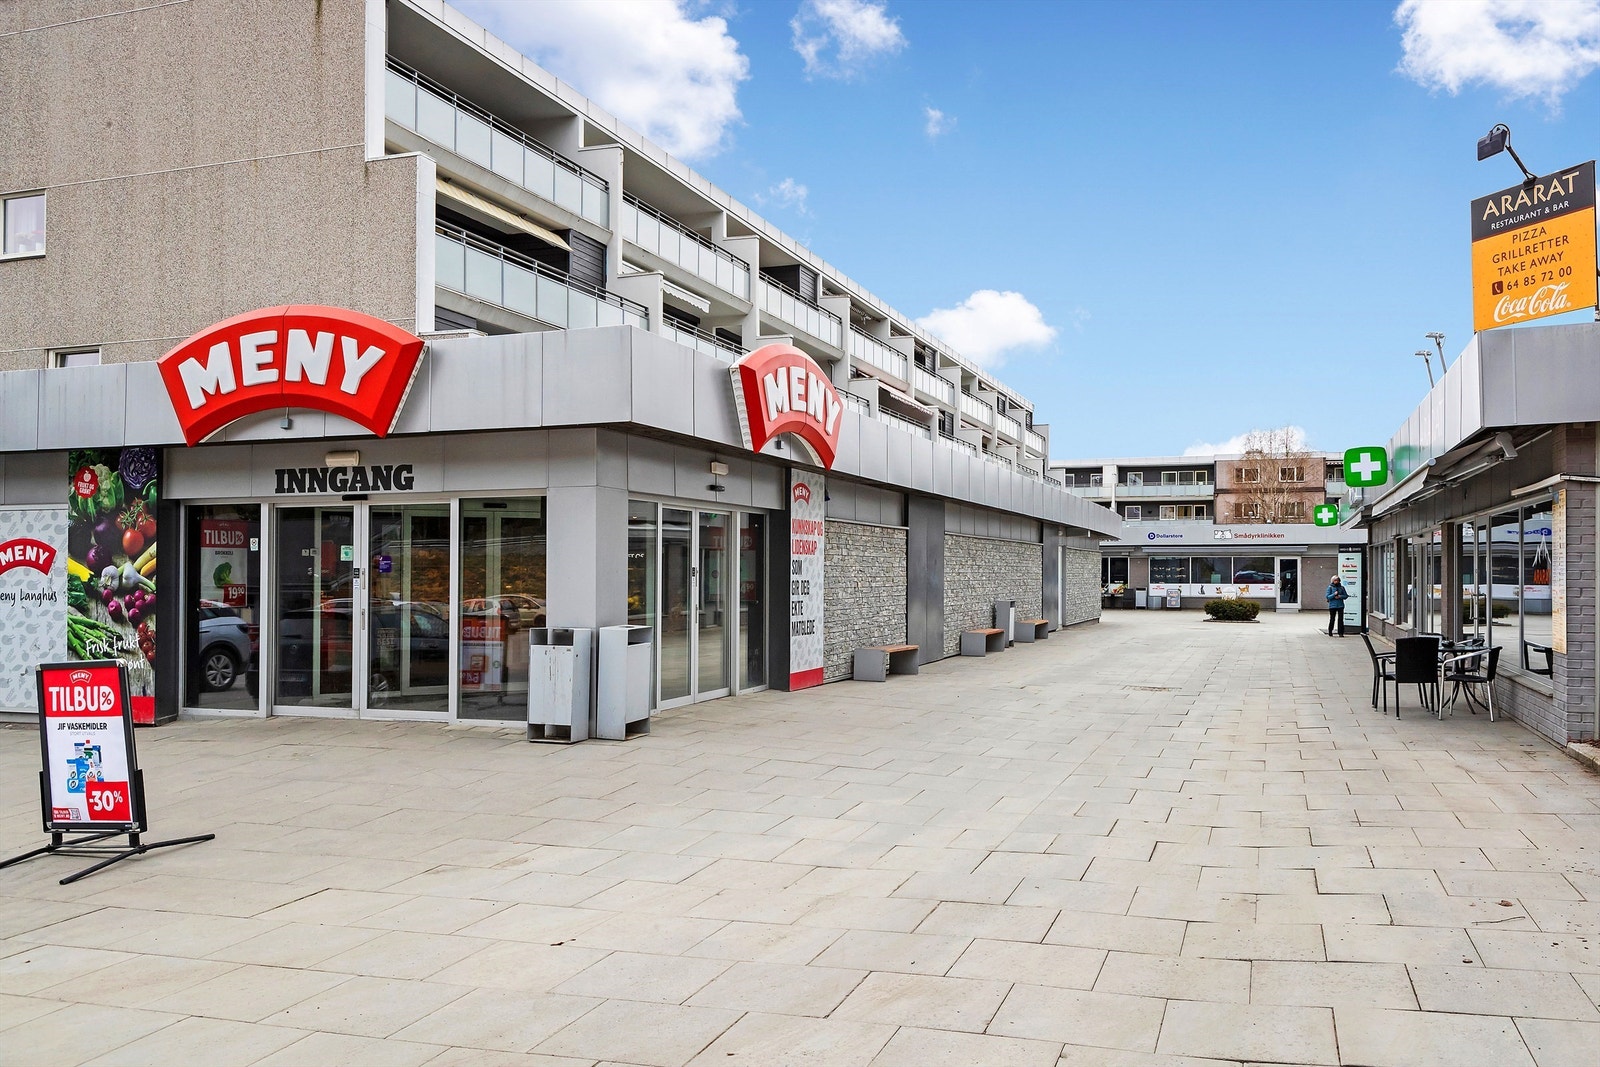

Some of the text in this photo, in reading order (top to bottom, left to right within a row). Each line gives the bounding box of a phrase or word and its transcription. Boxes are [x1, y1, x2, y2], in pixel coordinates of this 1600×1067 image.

[1482, 171, 1580, 221] ARARAT
[1491, 200, 1570, 230] RESTAURANT & BAR
[1512, 226, 1547, 244] PIZZA
[1492, 235, 1570, 264] GRILLRETTER
[1497, 251, 1564, 277] TAKE AWAY
[1506, 265, 1572, 291] 64 85 72 00
[178, 328, 387, 410] MENY
[763, 365, 841, 437] MENY
[274, 464, 415, 494] INNGANG
[794, 486, 809, 499] MENY
[792, 518, 823, 537] KUNNSKAP OG
[1233, 532, 1285, 540] Smådyrklinikken
[0, 544, 50, 566] MENY
[792, 539, 817, 555] LIDENSKAP
[792, 559, 802, 576] SOM
[20, 587, 57, 607] Langhus
[801, 580, 809, 595] DEG
[792, 600, 803, 616] EKTE
[792, 619, 815, 636] MATGLEDE
[86, 633, 140, 657] Frisk frukt
[72, 672, 90, 680] MENY
[57, 722, 108, 731] JIF VASKEMIDLER
[89, 790, 124, 812] -30%
